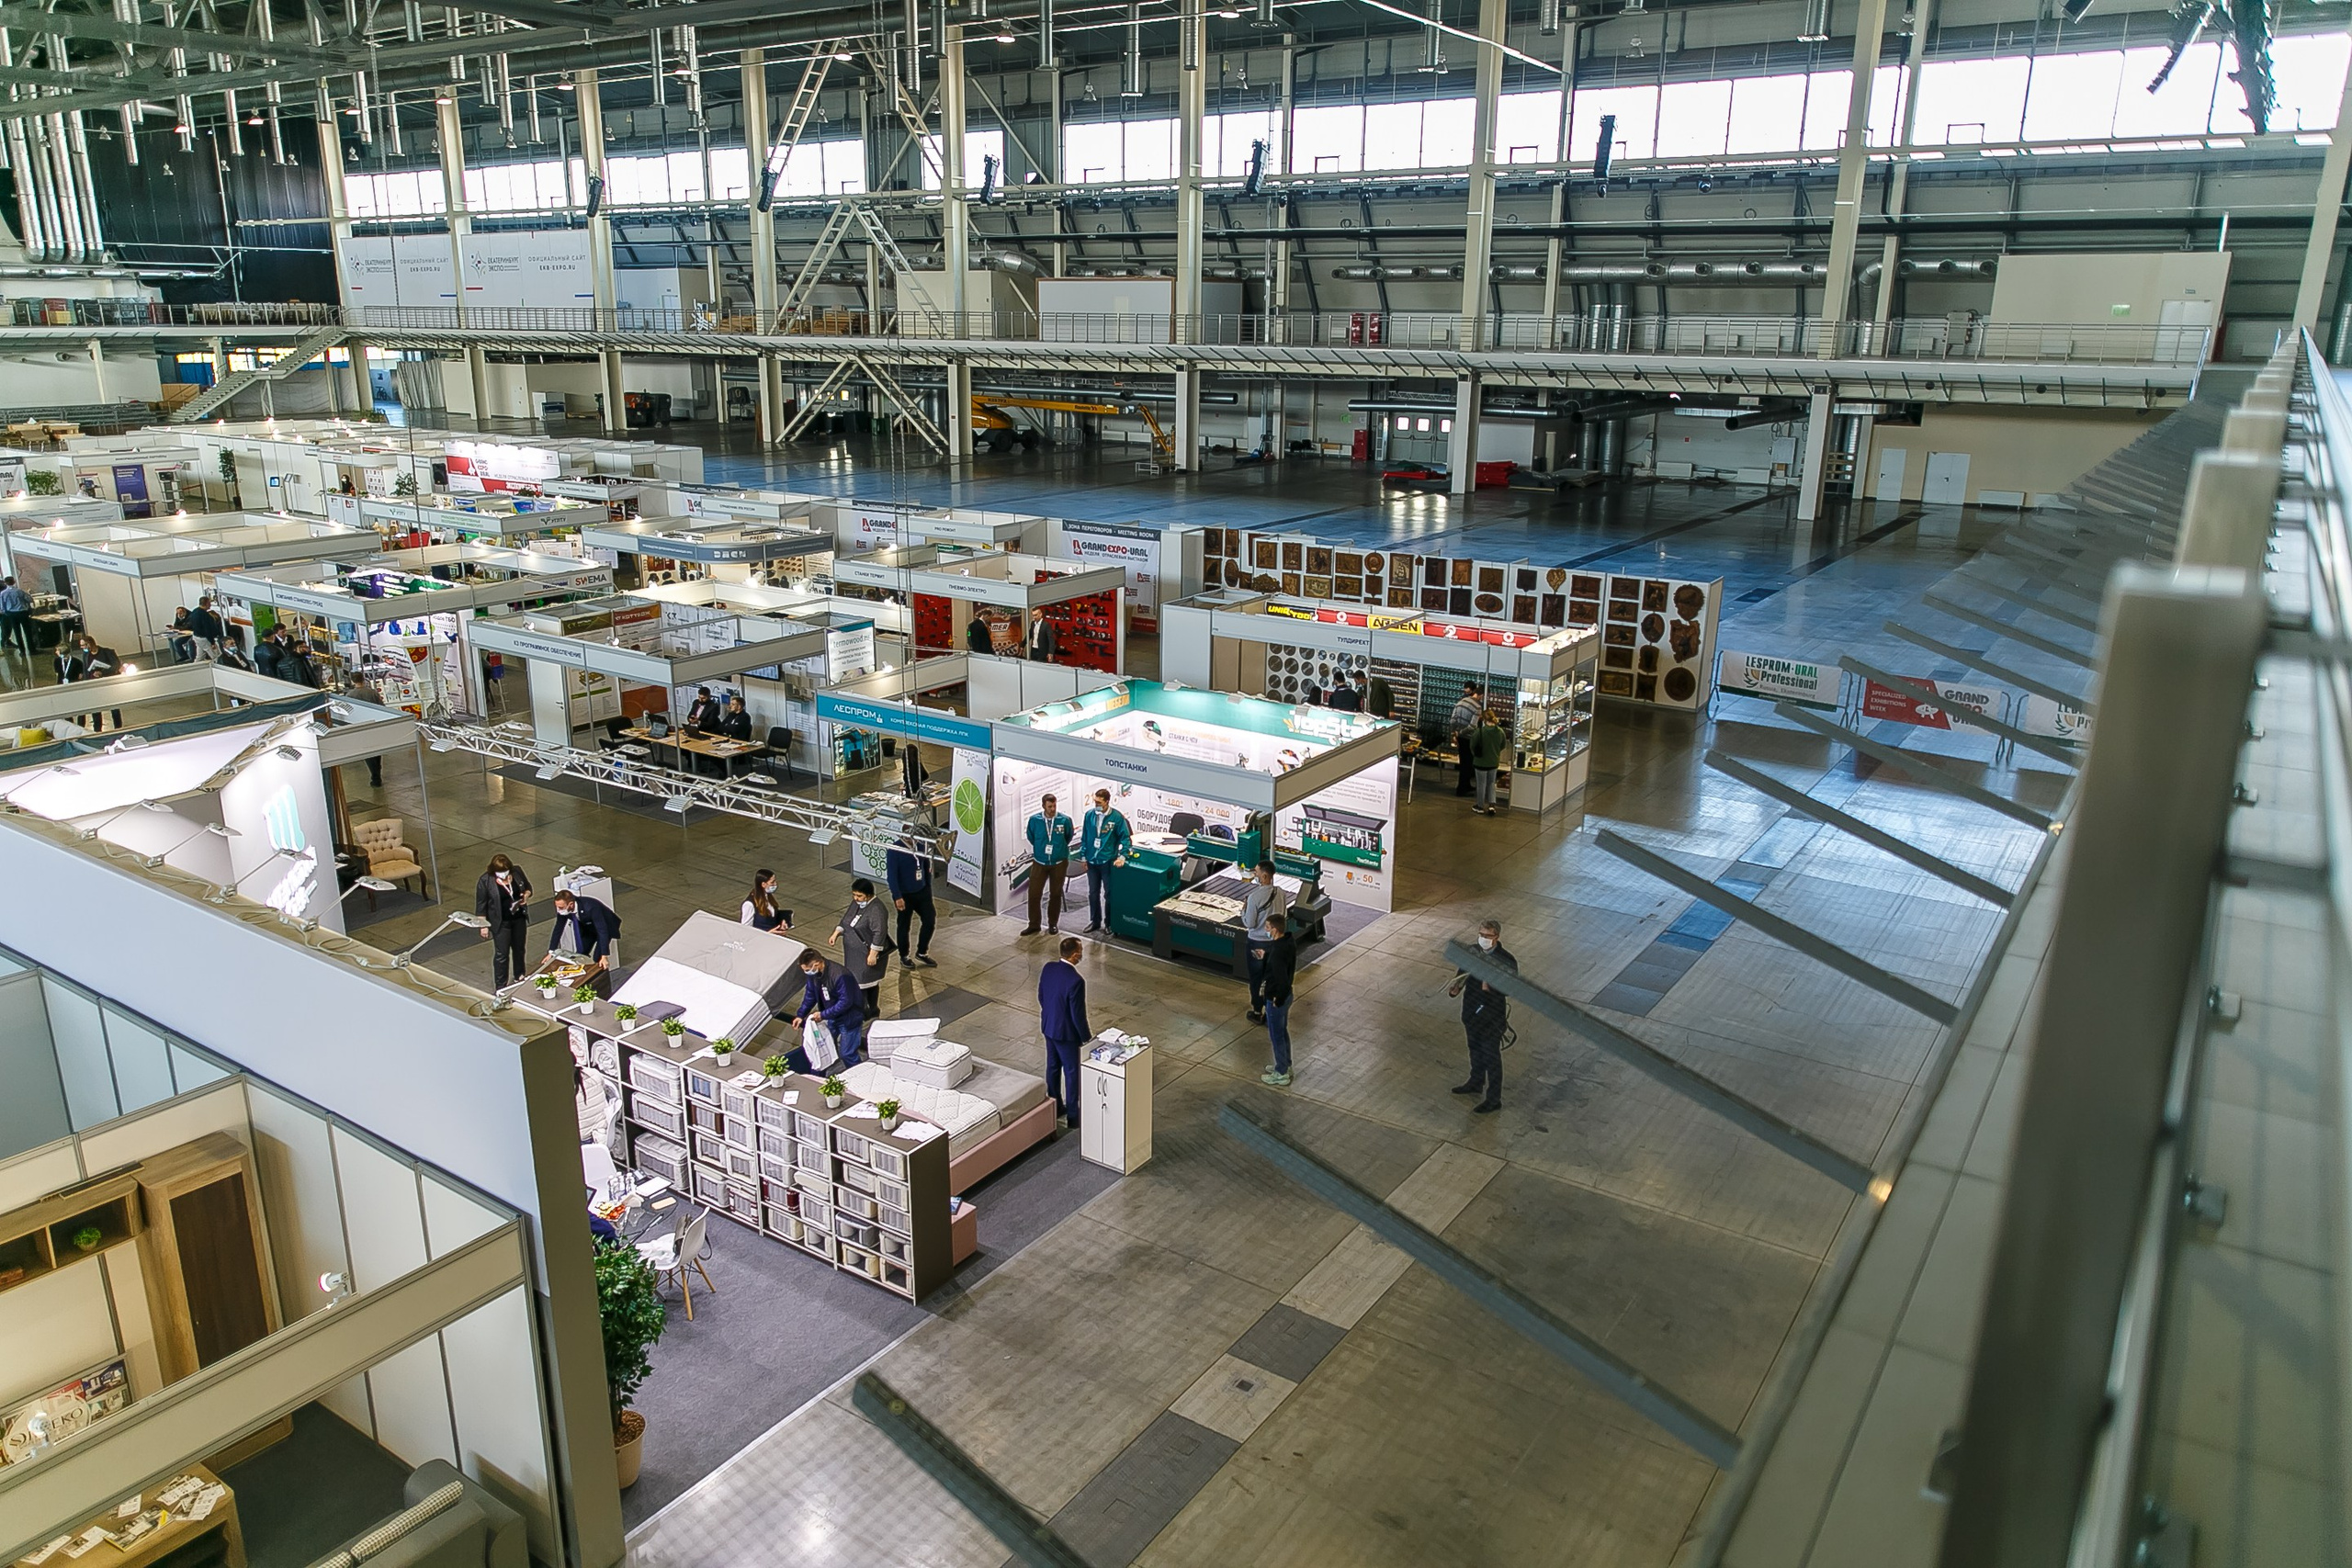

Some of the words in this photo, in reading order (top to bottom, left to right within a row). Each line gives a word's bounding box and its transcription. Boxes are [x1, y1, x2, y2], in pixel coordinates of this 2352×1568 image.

[487, 256, 519, 265] ЕКАТЕРИНБУРГ
[527, 254, 570, 263] ОФИЦИАЛЬНЫЙ
[1081, 525, 1113, 534] ПЕРЕГОВОРОВ
[575, 574, 606, 586] SWEMA
[948, 584, 988, 594] ПНЕВМО-ЭЛЕКТРО
[1337, 637, 1370, 646] ТУЛДИРЕКТ
[520, 641, 549, 652] ПРОГРАММНОЕ
[550, 647, 582, 659] ОБЕСПЕЧЕНИЕ
[1760, 671, 1818, 690] Professional
[1871, 690, 1907, 700] SPECIALIZED
[1944, 690, 1990, 705] GRAND
[1871, 697, 1907, 707] EXHIBITIONS
[1870, 705, 1887, 713] WEEK
[833, 704, 876, 719] ЛЕСПРОМ
[927, 724, 958, 735] ПОДДЕРЖКА
[1104, 758, 1148, 773] ТОПСТАНКИ
[1136, 808, 1172, 825] ОБОРУДОВ
[1204, 806, 1214, 814] 24
[1216, 807, 1230, 818] 000
[1363, 874, 1374, 884] 50
